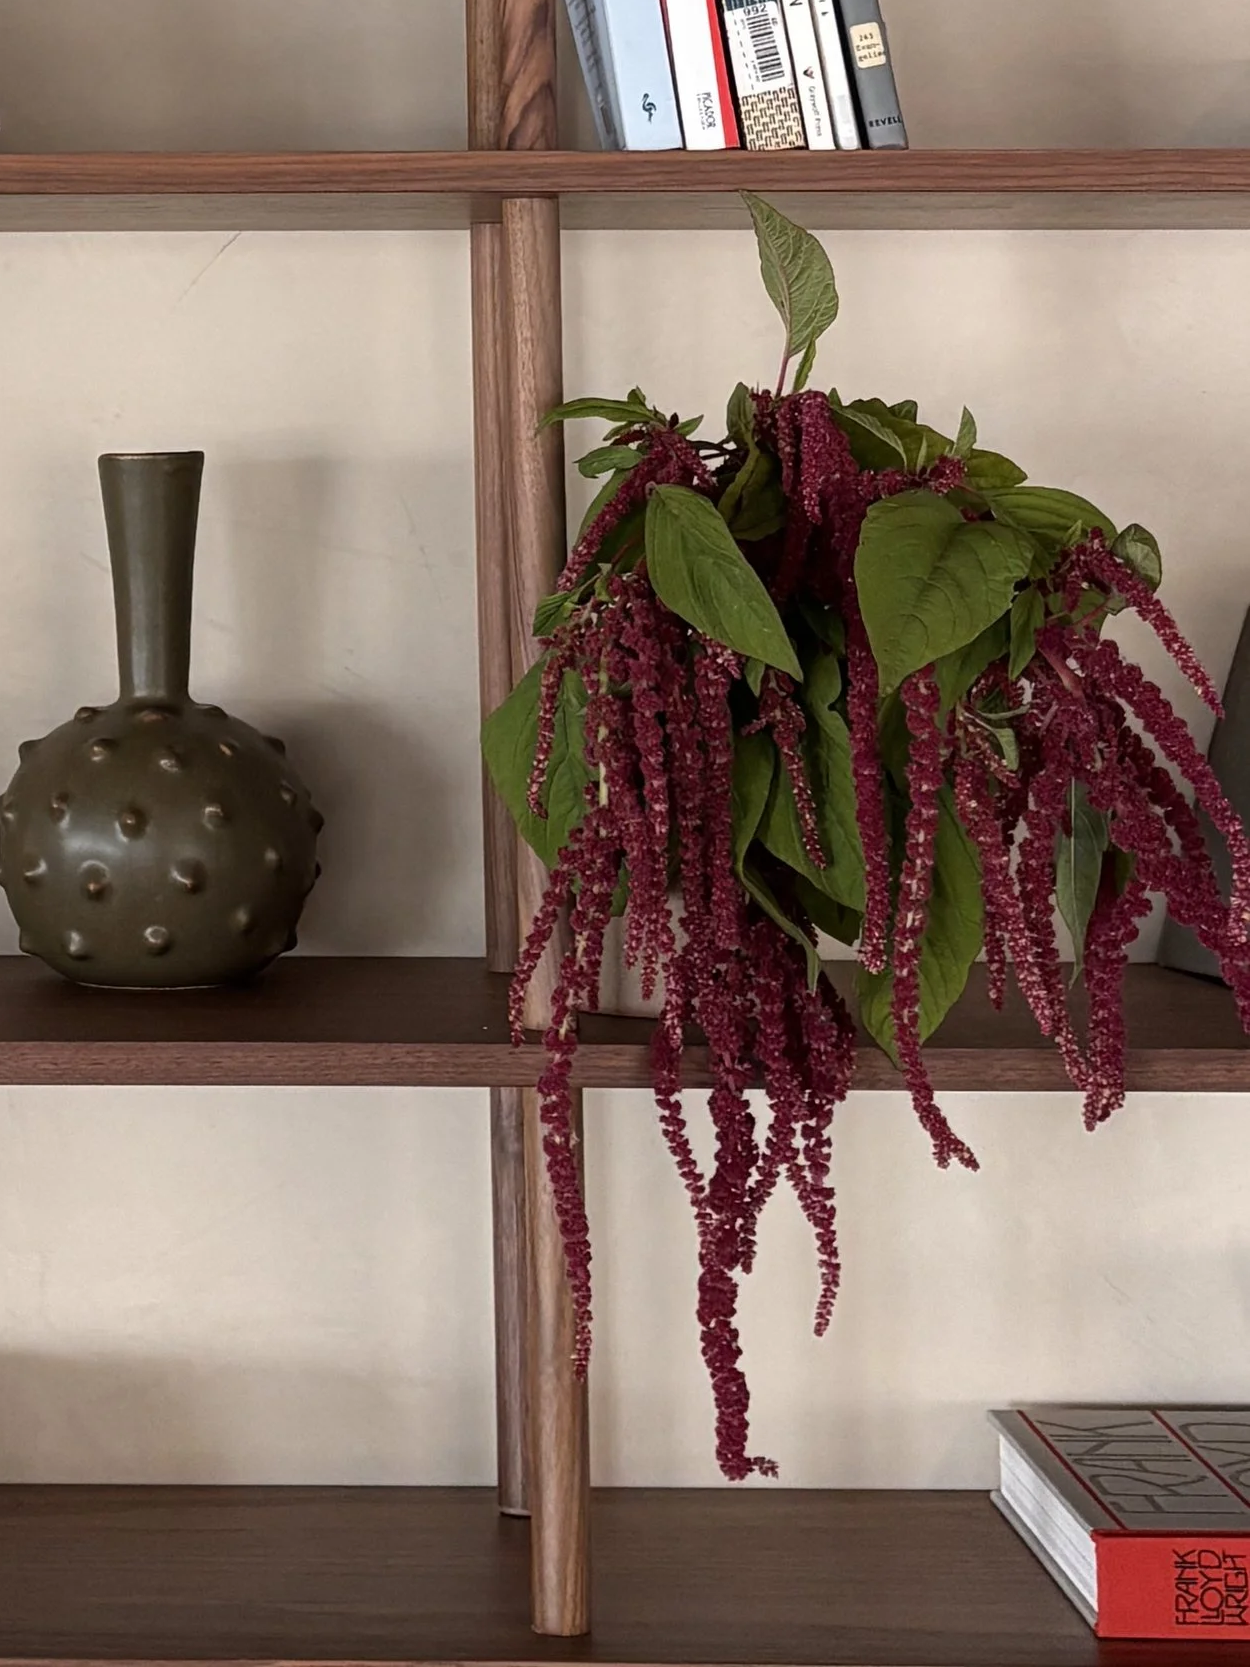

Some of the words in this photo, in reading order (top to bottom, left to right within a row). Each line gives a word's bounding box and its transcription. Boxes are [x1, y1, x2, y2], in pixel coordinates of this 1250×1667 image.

[743, 3, 768, 16] 992
[702, 92, 716, 129] PICADOR
[1173, 1549, 1199, 1626] FRANK
[1196, 1550, 1225, 1626] LLOYD
[1222, 1549, 1249, 1626] WRIGHT
